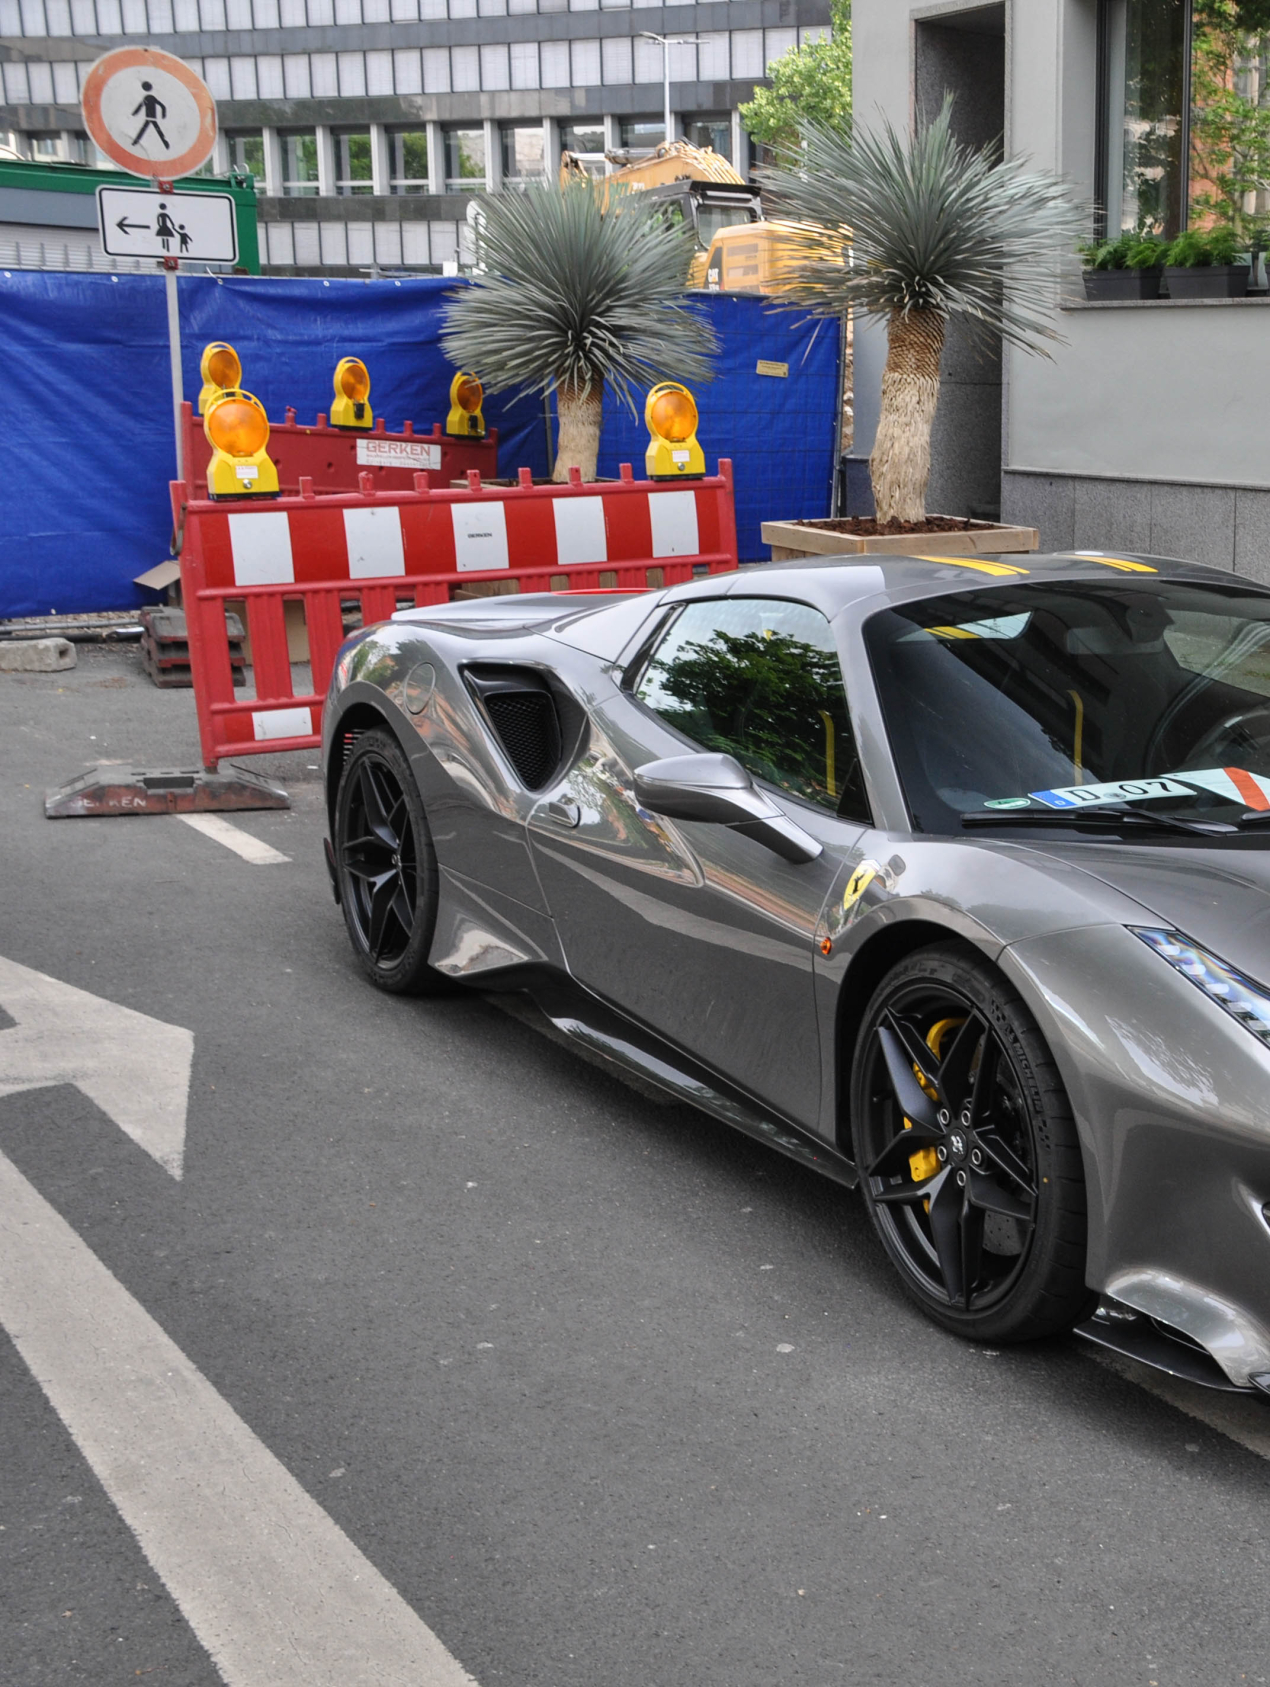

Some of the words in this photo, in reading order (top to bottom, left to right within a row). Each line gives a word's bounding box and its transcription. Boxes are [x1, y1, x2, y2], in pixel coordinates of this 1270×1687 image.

[708, 268, 719, 282] CAT
[366, 441, 431, 456] GERKEN
[1064, 789, 1102, 801] D
[1118, 781, 1173, 795] 07
